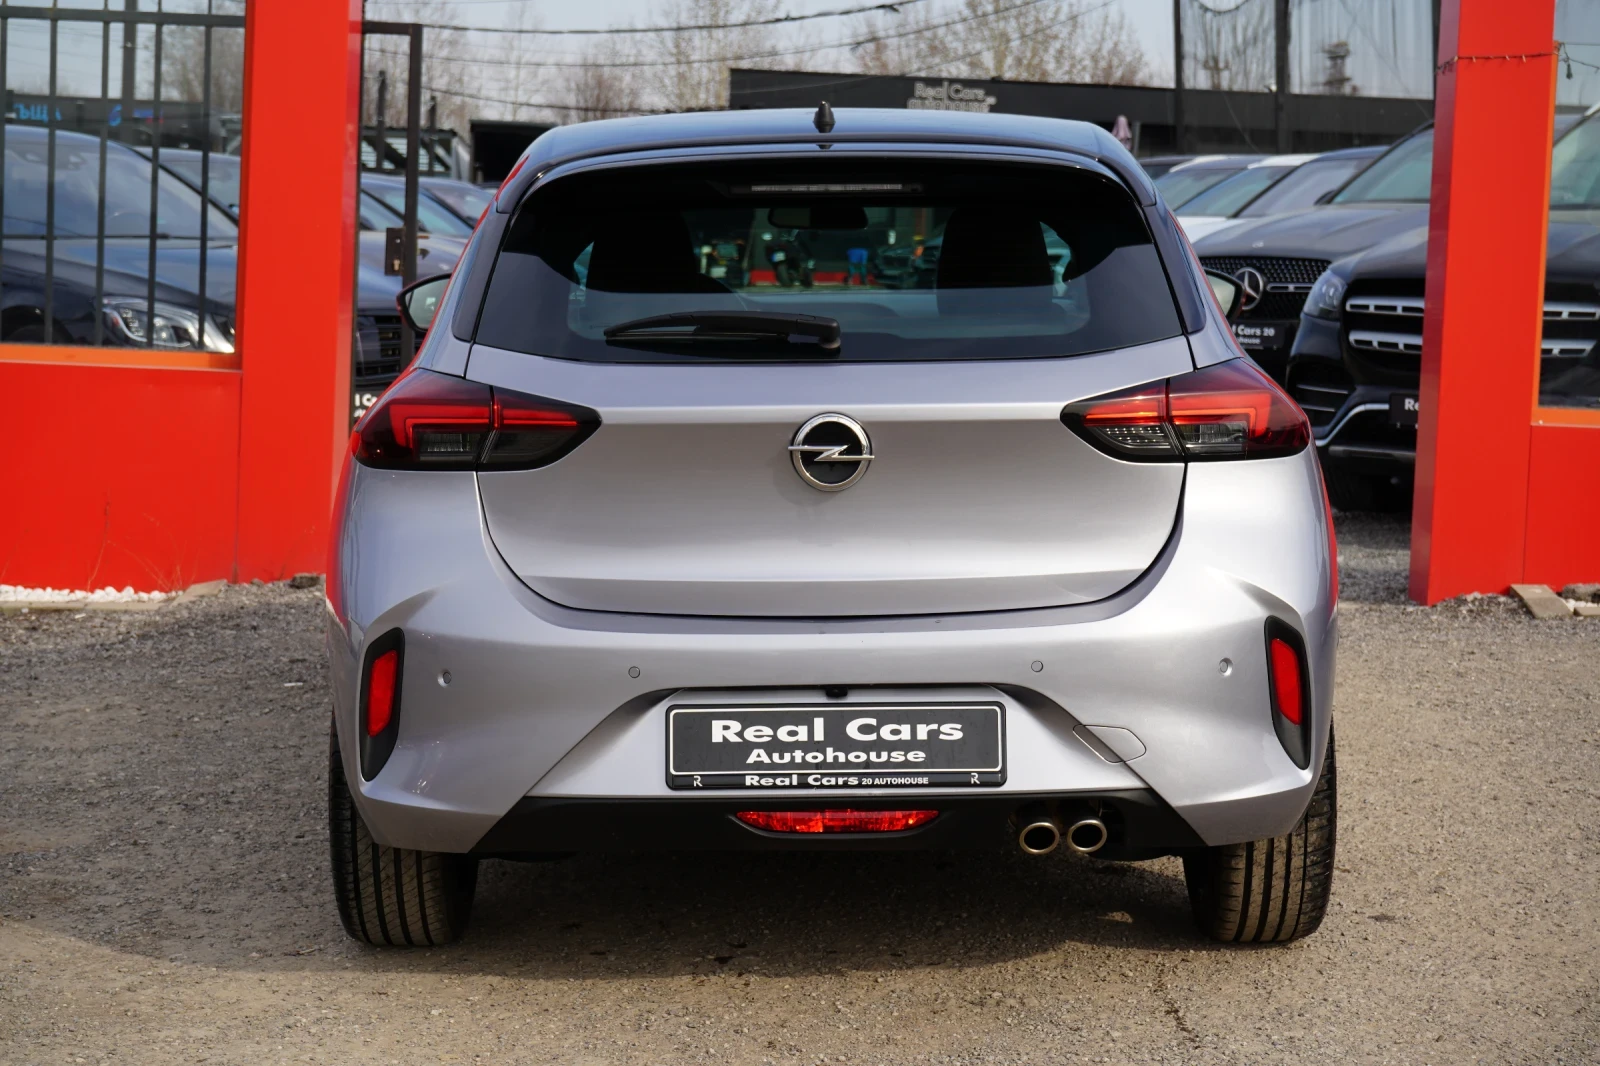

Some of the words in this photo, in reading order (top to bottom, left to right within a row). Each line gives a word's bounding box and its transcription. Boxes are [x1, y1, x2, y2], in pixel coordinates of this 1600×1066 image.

[914, 81, 949, 98] Real
[1237, 324, 1261, 337] Cars
[1262, 327, 1275, 337] 20
[711, 717, 825, 743] Real
[845, 717, 964, 742] Cars
[745, 747, 927, 764] Autohouse
[745, 774, 798, 786] Real
[807, 774, 859, 786] Cars
[874, 777, 929, 785] AUTOHOUSE
